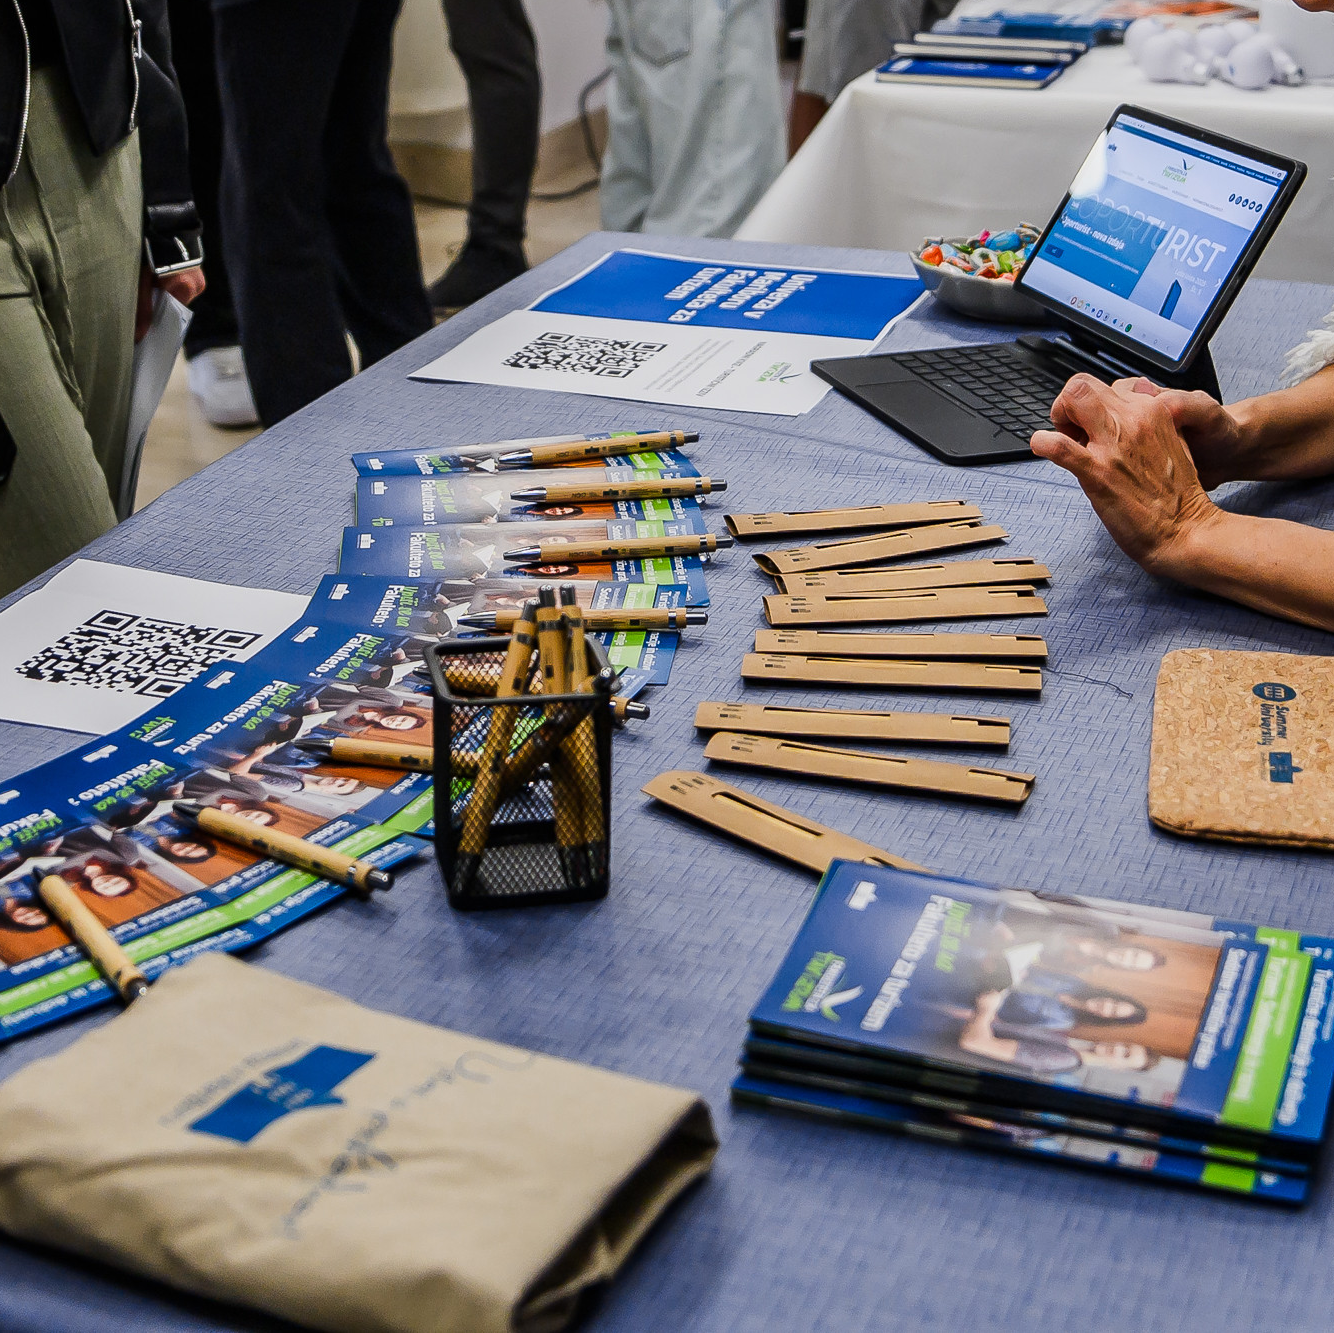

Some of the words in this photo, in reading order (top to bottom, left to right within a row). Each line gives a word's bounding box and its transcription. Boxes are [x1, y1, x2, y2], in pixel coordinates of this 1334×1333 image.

[1078, 193, 1227, 273] OPORTURIST
[665, 268, 731, 301] turizem
[682, 269, 759, 309] Fakulteta
[716, 271, 790, 310] Mariboru
[750, 274, 819, 309] Univerza
[665, 309, 701, 320] za
[413, 454, 433, 474] Fakulte
[420, 479, 437, 512] Fakulteto
[422, 512, 434, 521] za
[408, 532, 425, 567] Fakulteto
[408, 567, 421, 578] za
[371, 584, 404, 623] Fakulteto
[315, 633, 372, 673] Fakulteto
[354, 636, 384, 663] Vpiši
[224, 679, 287, 724] Fakulteto
[255, 702, 274, 720] se
[267, 681, 301, 712] Vpiši
[204, 716, 229, 738] za
[1256, 703, 1275, 745] University
[1275, 705, 1289, 738] Summer
[172, 729, 208, 758] turiz
[77, 757, 163, 803] Fakulteto
[112, 782, 136, 801] se
[133, 762, 174, 791] Vpiši
[13, 814, 62, 845] Vpiši
